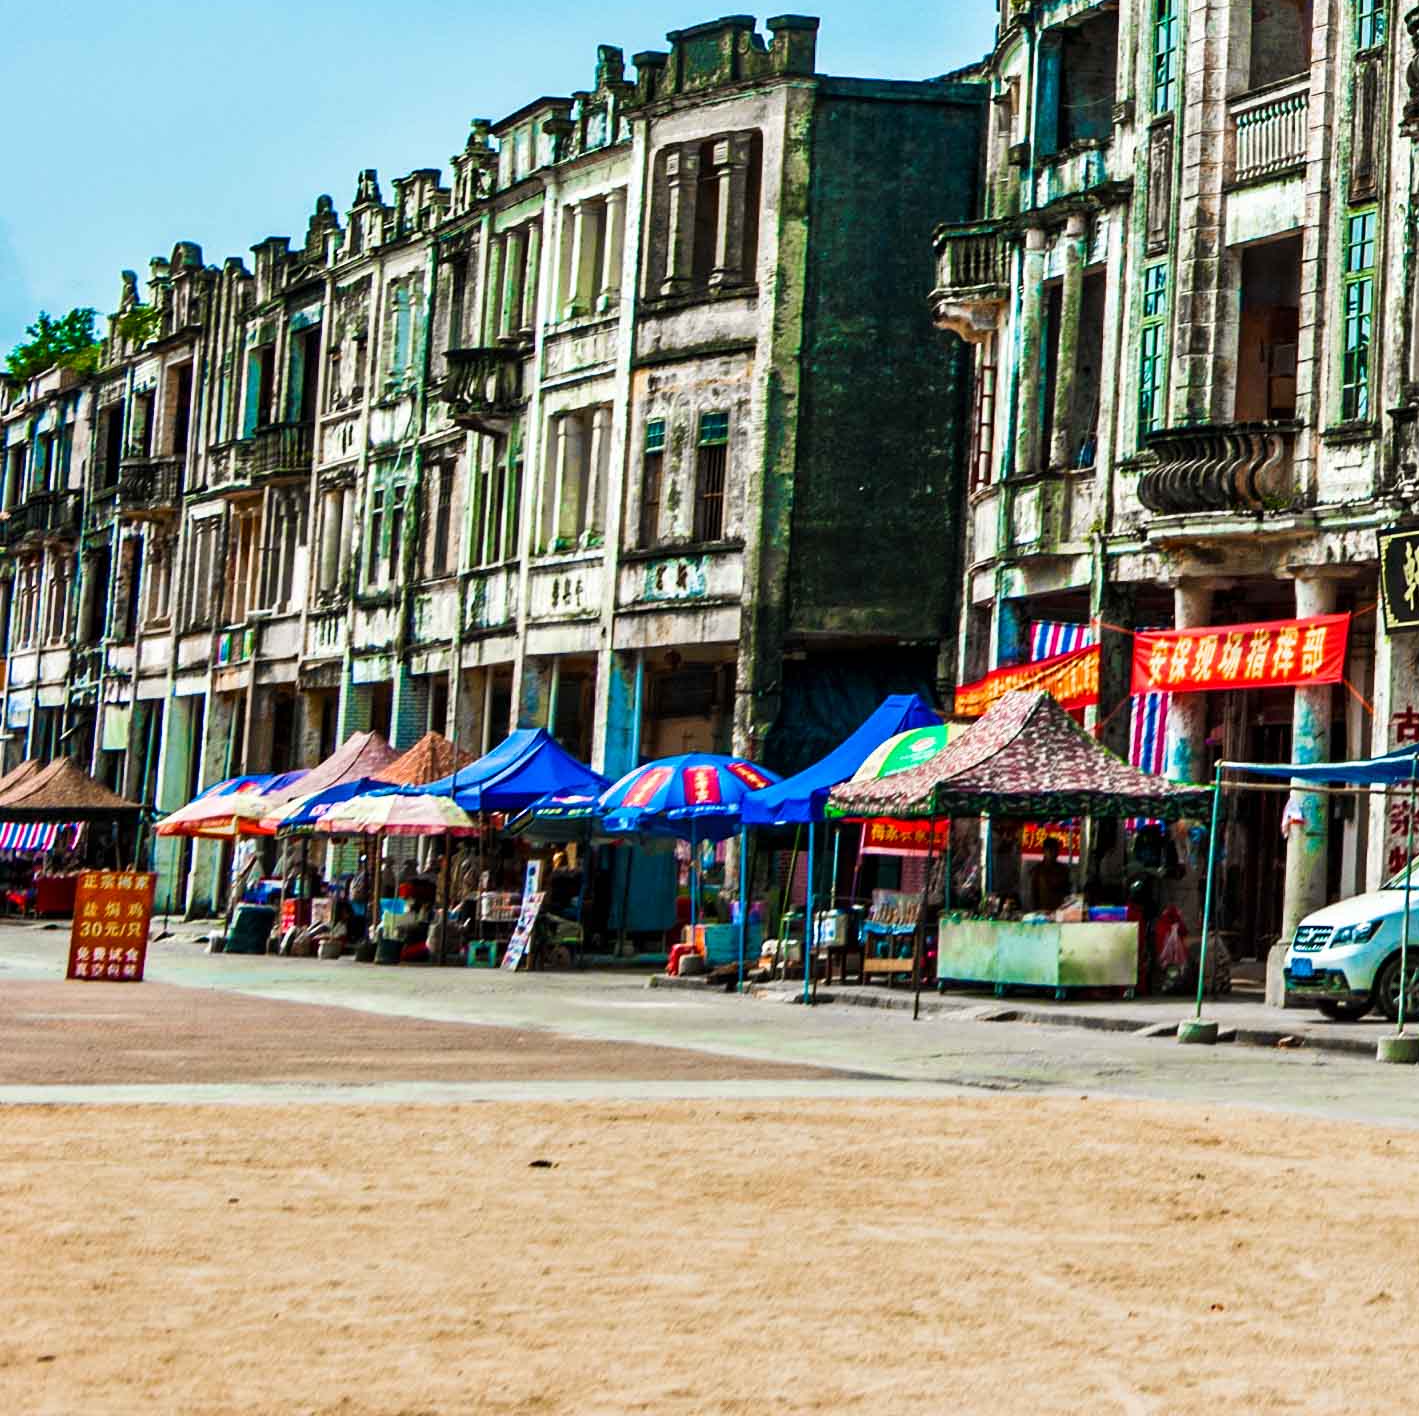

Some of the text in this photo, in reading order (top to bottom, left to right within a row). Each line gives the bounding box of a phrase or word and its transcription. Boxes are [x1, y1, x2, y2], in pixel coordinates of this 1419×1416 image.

[1148, 625, 1328, 686] 安保现场指挥部
[79, 921, 142, 937] 30元/只
